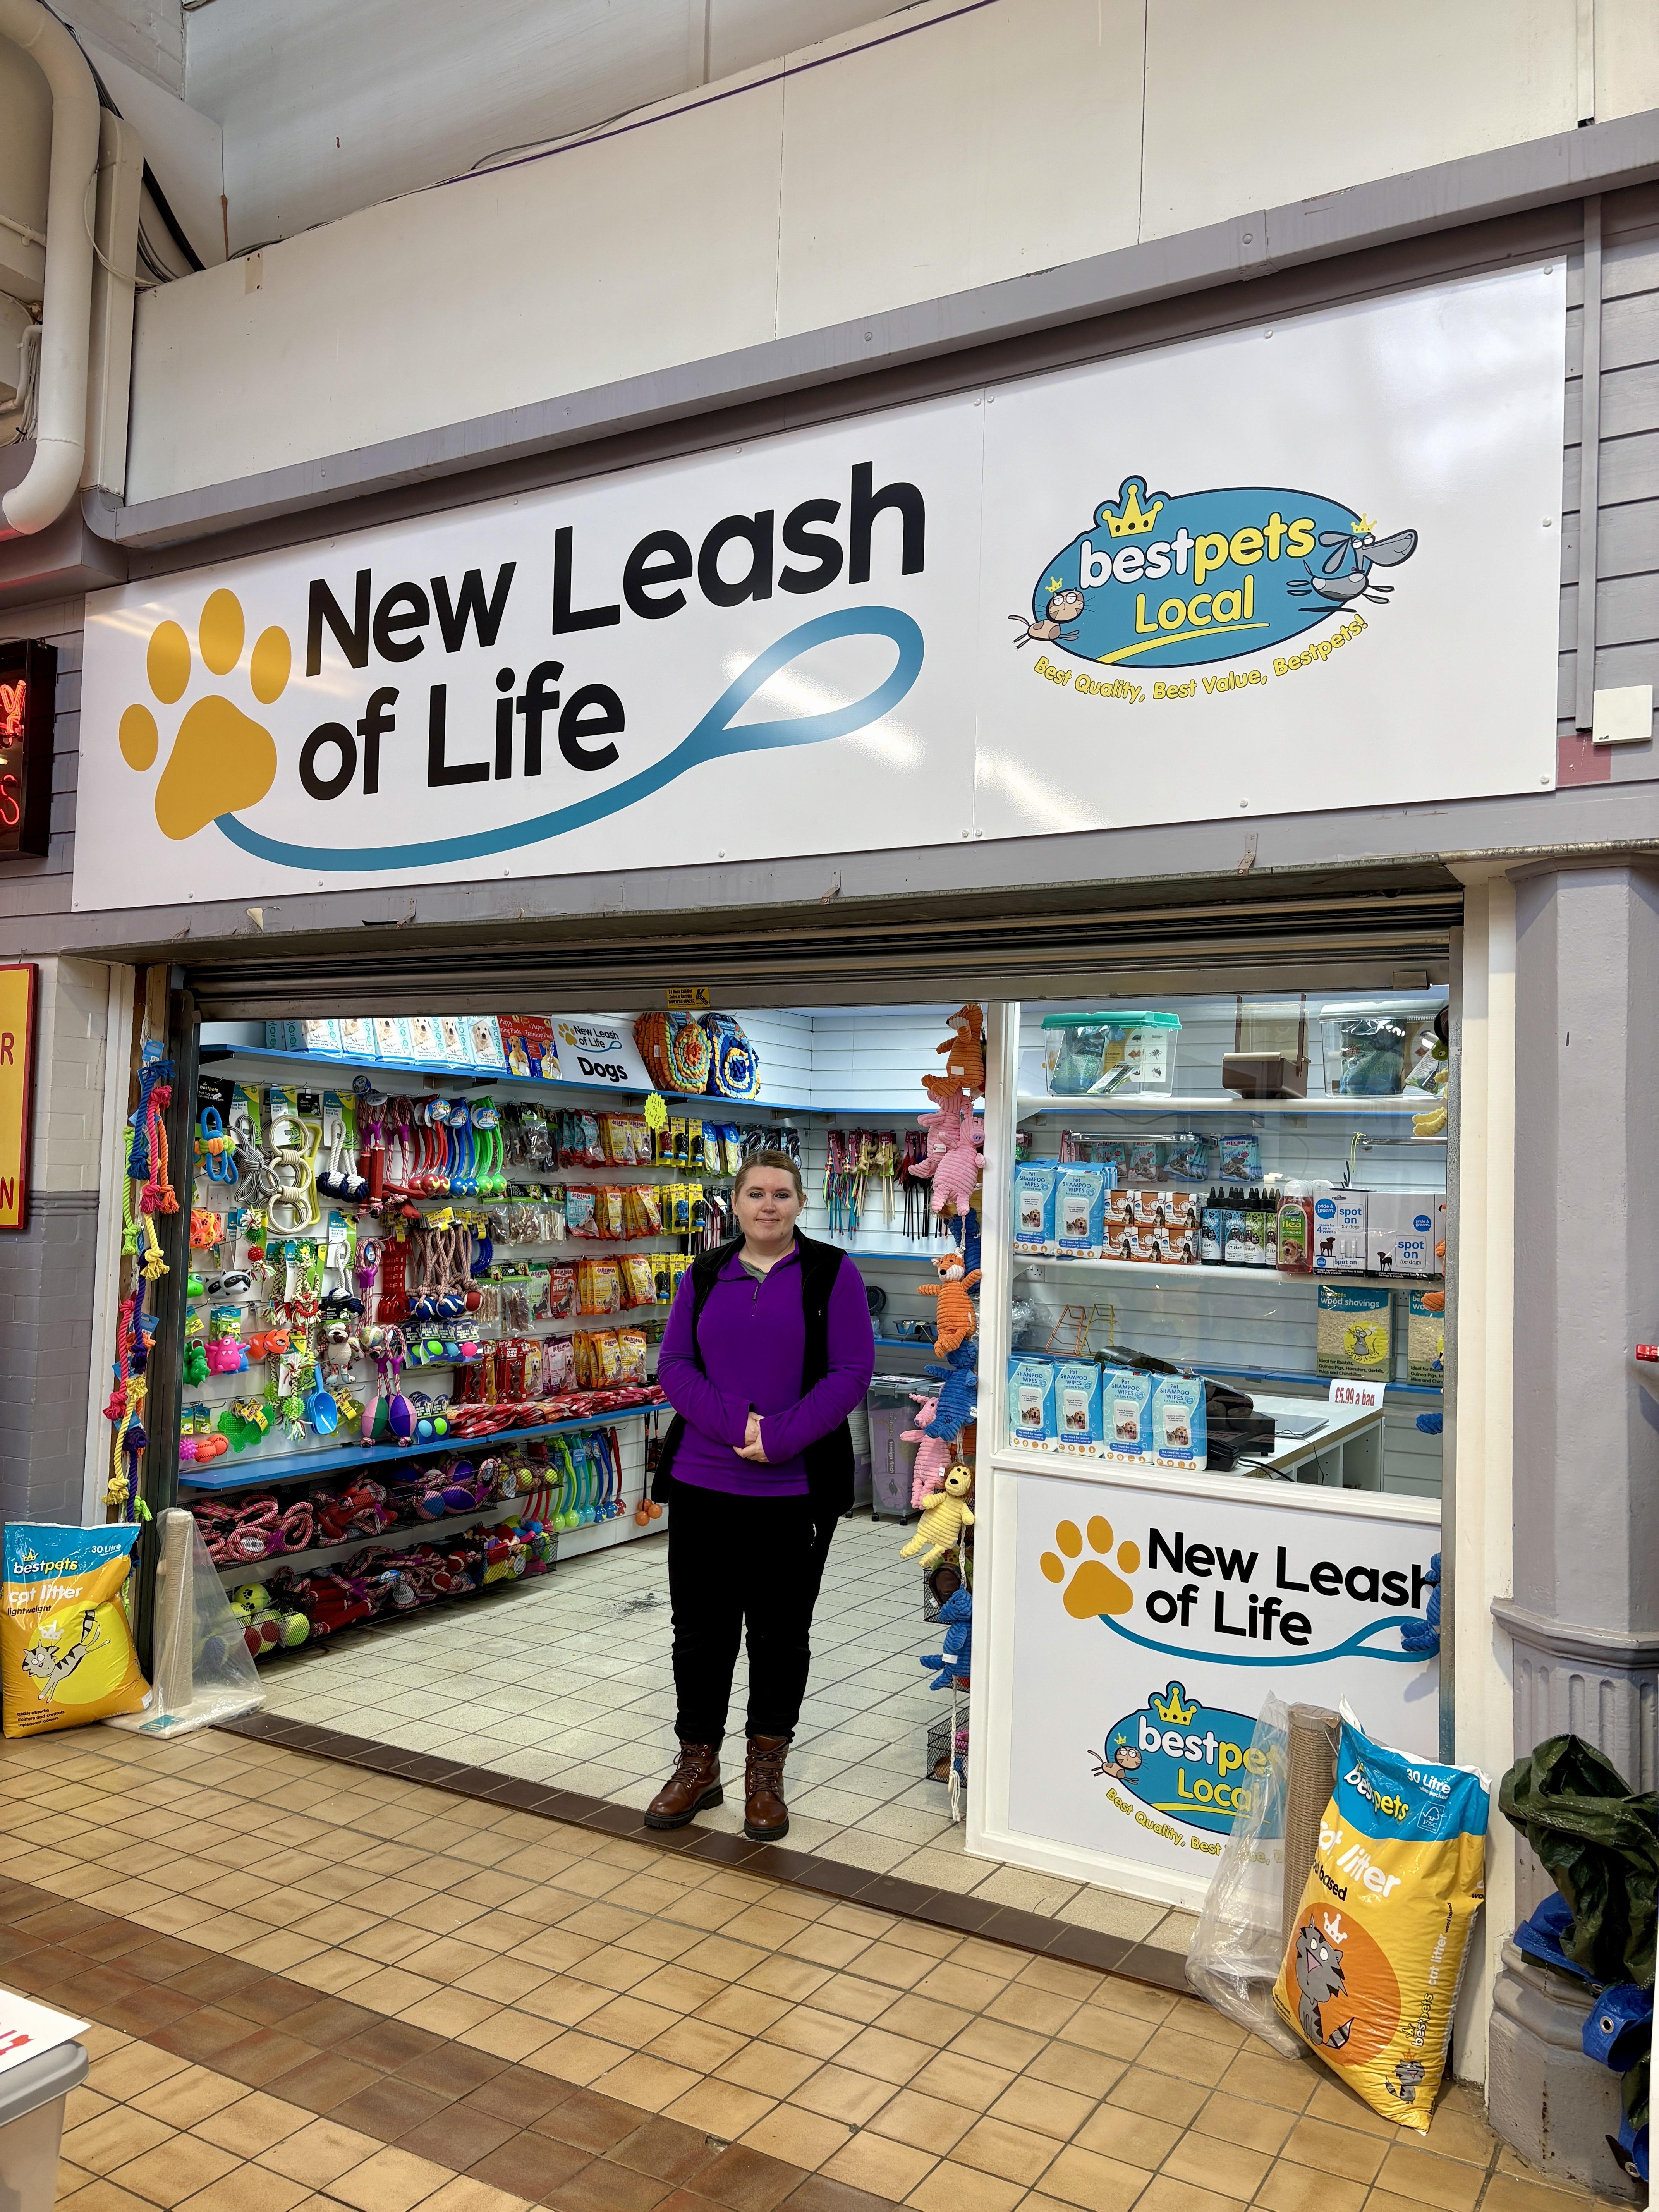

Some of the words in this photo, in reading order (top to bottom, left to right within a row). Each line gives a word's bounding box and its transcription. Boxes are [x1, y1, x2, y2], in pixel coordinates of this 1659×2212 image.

[1079, 512, 1316, 589] bestpets
[306, 562, 516, 677] New
[552, 461, 925, 634] Leash
[1135, 575, 1254, 635] Local
[1033, 656, 1072, 686] Best
[1074, 674, 1146, 704] Quality,
[1153, 681, 1197, 700] Best
[1202, 669, 1268, 694] Value,
[1273, 614, 1369, 677] Bestpets!
[299, 687, 400, 800] of
[428, 661, 625, 787] Life
[500, 1018, 513, 1026] Puppy
[531, 1023, 545, 1031] Puppy
[525, 1030, 543, 1038] Training
[573, 1025, 592, 1036] New
[594, 1028, 619, 1039] Leash
[579, 1037, 588, 1046] of
[590, 1038, 605, 1048] Life
[577, 1056, 628, 1082] Dogs
[1339, 1208, 1362, 1217] spot
[1398, 1241, 1424, 1250] spot
[1403, 1250, 1418, 1259] on
[1345, 1298, 1379, 1309] shavings
[1334, 1386, 1355, 1405] £5.99
[1355, 1392, 1360, 1405] a
[104, 1544, 122, 1553] Litre
[1148, 1527, 1259, 1584] New
[14, 1558, 78, 1575] bestpets
[9, 1587, 37, 1602] cat
[40, 1585, 83, 1599] litter
[7, 1604, 52, 1617] lightweight
[1146, 1584, 1200, 1624] of
[1214, 1592, 1312, 1646] Life
[46, 1710, 65, 1718] controls
[1406, 1768, 1420, 1784] 30
[1422, 1774, 1451, 1794] Litre
[1429, 1789, 1448, 1800] packed
[1106, 1788, 1134, 1816] Best
[1135, 1811, 1186, 1848] Quality,
[1191, 1836, 1223, 1856] Best
[1423, 1819, 1438, 1828] FSC
[1319, 1864, 1347, 1901] based
[1431, 1934, 1447, 1963] litter
[1428, 1966, 1440, 1986] cat
[1412, 1993, 1433, 2047] bestpets
